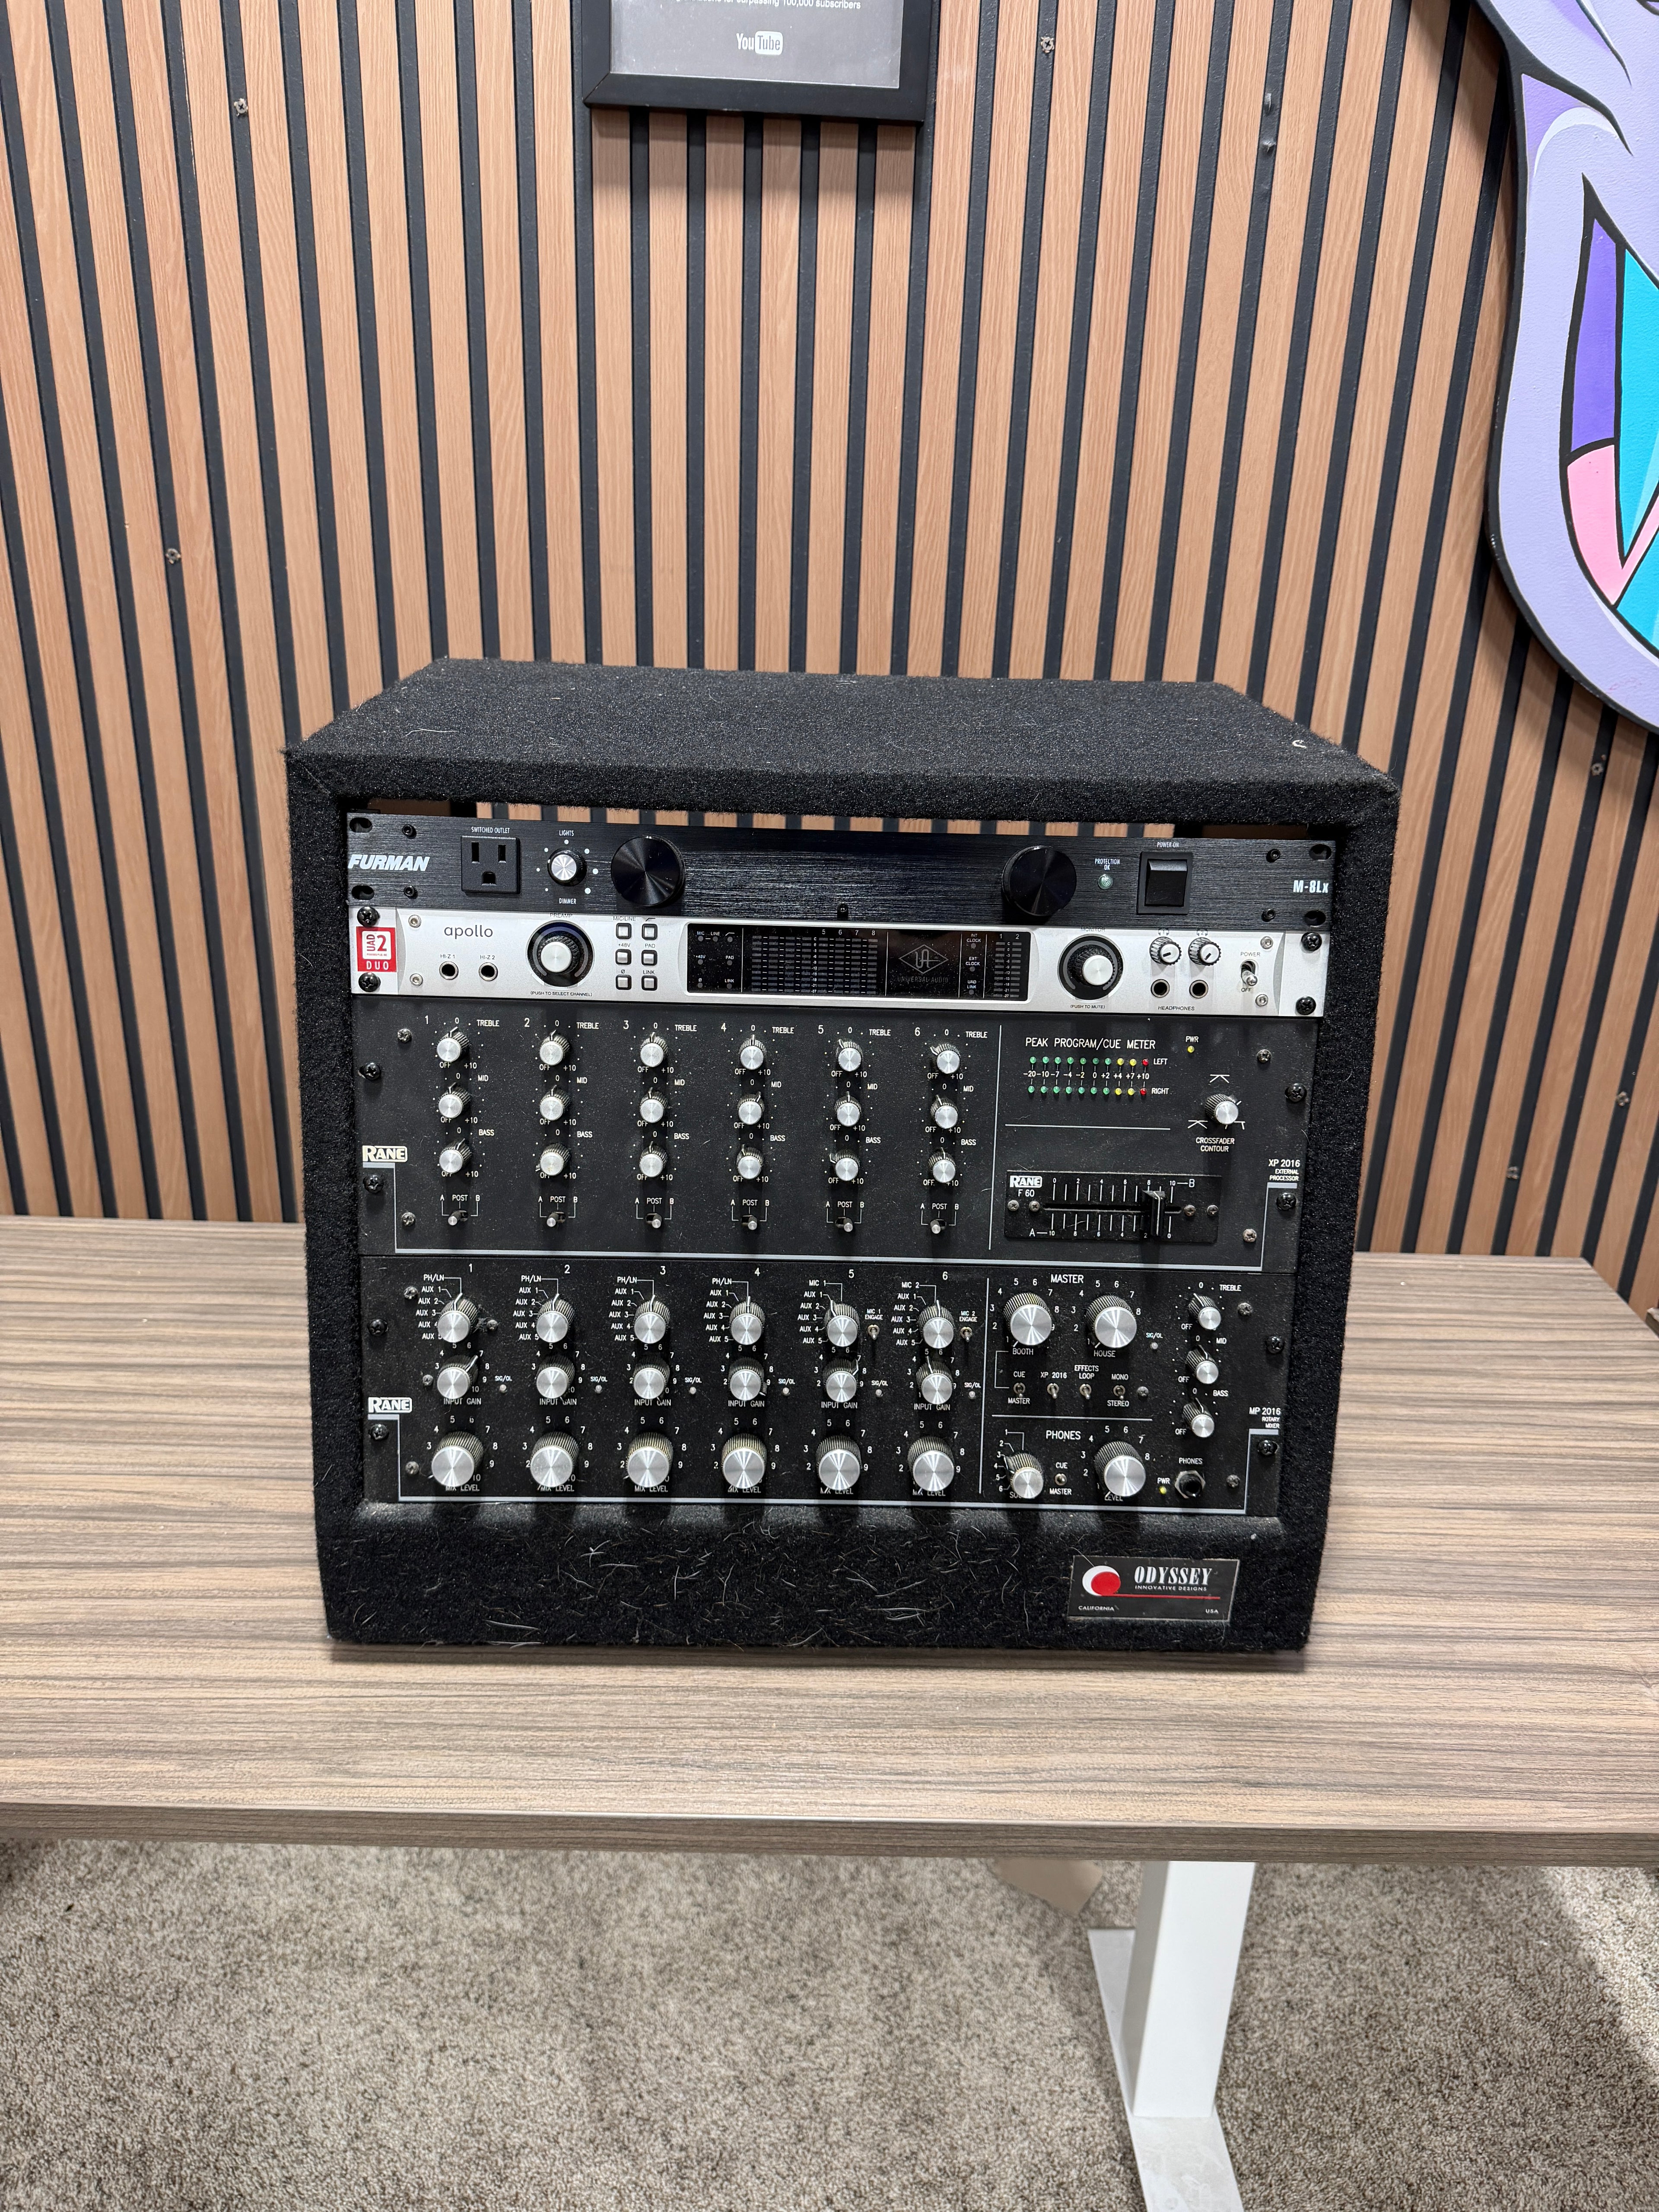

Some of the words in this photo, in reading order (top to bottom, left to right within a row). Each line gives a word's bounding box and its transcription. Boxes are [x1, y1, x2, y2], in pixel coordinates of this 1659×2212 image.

[816, 0, 861, 9] subscribers
[736, 31, 783, 55] YouTube
[348, 854, 430, 871] FURMAN
[1293, 880, 1328, 893] M-8Lx
[444, 925, 493, 939] apollo
[366, 934, 375, 951] UAD
[377, 935, 387, 951] 2
[366, 961, 388, 970] DUO
[425, 1015, 428, 1024] 1
[524, 1018, 530, 1027] 2
[623, 1020, 629, 1029] 3
[721, 1023, 726, 1032] 4
[818, 1025, 823, 1034] 5
[915, 1027, 920, 1036] 6
[1026, 1037, 1048, 1047] PEAK
[1055, 1038, 1121, 1050] PROGRAM/CUE
[1127, 1040, 1155, 1049] METER
[362, 1145, 407, 1162] RANE
[1010, 1176, 1042, 1188] RANE
[469, 1264, 472, 1272] 1
[565, 1265, 570, 1273] 2
[660, 1266, 665, 1274] 3
[755, 1268, 760, 1276] 4
[424, 1274, 445, 1282] PH/LN
[849, 1269, 854, 1278] 5
[943, 1271, 947, 1280] 6
[521, 1274, 543, 1283] PH/LN
[617, 1276, 639, 1284] PH/LN
[712, 1278, 731, 1286] PH/LN
[1051, 1274, 1084, 1283] MASTER
[368, 1397, 412, 1413] RANE
[1046, 1430, 1081, 1440] PHONES
[1135, 1566, 1212, 1585] ODYSSEY
